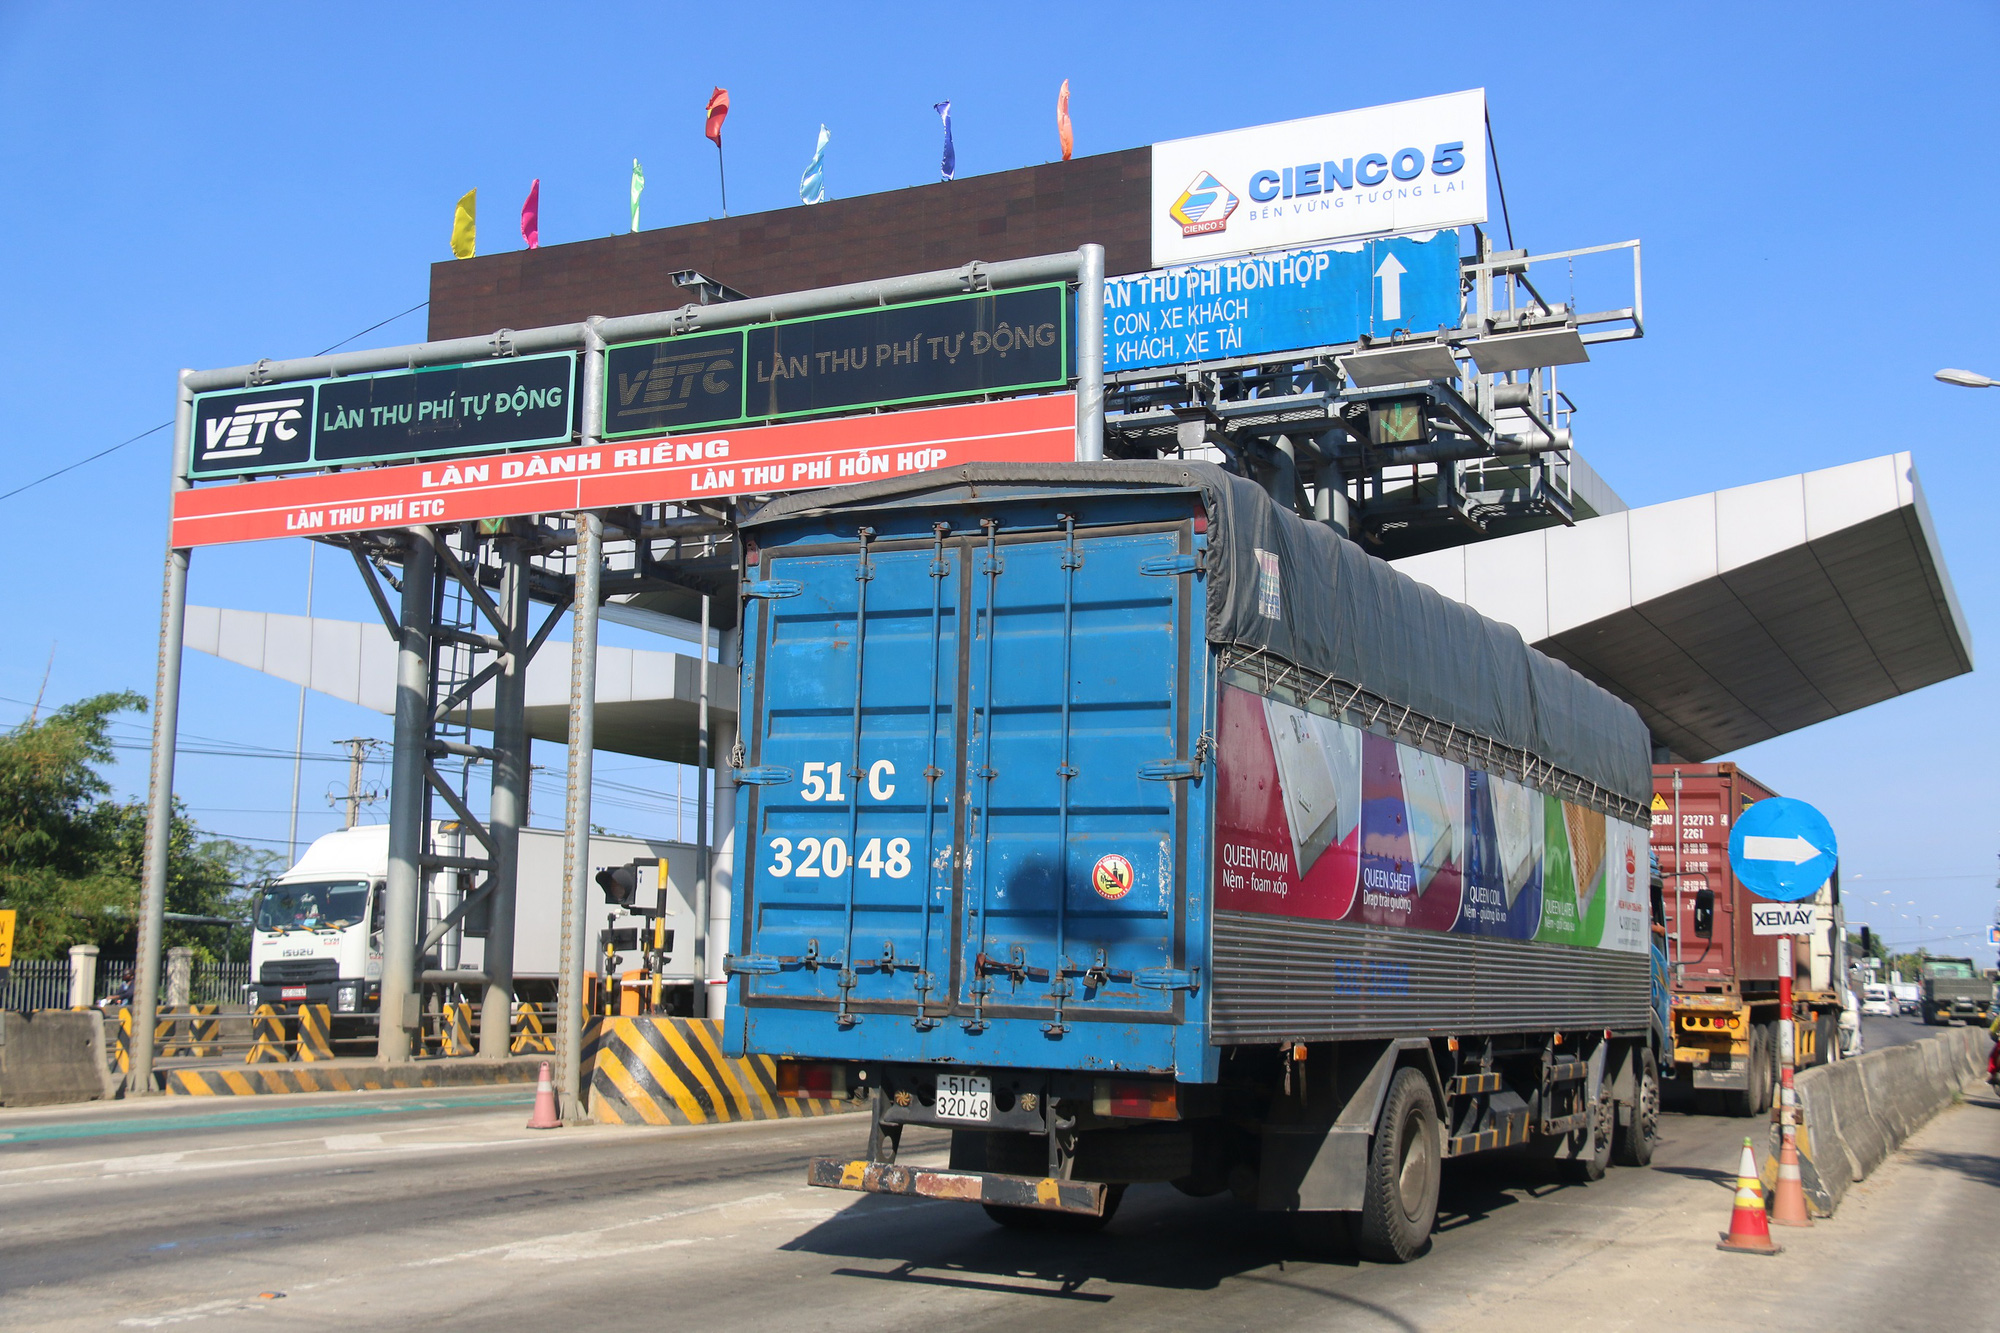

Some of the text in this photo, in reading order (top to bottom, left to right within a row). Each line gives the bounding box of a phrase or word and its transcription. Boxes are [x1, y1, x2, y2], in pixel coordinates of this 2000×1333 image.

[1249, 141, 1465, 203] CIENCO 5
[1294, 198, 1344, 214] VỮNG
[1355, 186, 1422, 205] TƯƠNG
[1433, 180, 1465, 194] LAI
[1183, 220, 1224, 234] CIENCO 5
[1137, 275, 1180, 305] THU
[1280, 254, 1330, 289] HỢP
[1160, 307, 1183, 330] XE
[1188, 297, 1248, 326] KHÁCH
[757, 321, 1056, 383] LÀN THU PHÍ TỰ ĐỘNG
[1184, 331, 1209, 355] XE
[1216, 323, 1242, 350] TẢI
[618, 358, 734, 408] VETC
[323, 384, 563, 432] LÀN THU PHÍ TỰ ĐỘNG
[205, 405, 303, 452] VETC
[421, 439, 730, 488] LÀN DÀNH RIÊNG
[690, 448, 947, 491] LÀN THU PHÍ HỖN HỢP
[286, 498, 445, 531] LÀN THU PHÍ ETC
[800, 759, 896, 802] 51 C
[1682, 815, 1714, 826] 232713
[1223, 843, 1288, 874] QUEEN FOAM
[1222, 869, 1244, 892] Nệm
[1251, 872, 1271, 893] foam
[1272, 875, 1288, 898] xốp
[1363, 868, 1412, 892] QUEEN SHEET
[1469, 886, 1490, 905] QUEEN
[1363, 889, 1378, 909] Drap
[1379, 891, 1390, 908] trải
[282, 948, 314, 957] ISUZU
[949, 1076, 977, 1097] 51C
[938, 1096, 988, 1118] 320.48
